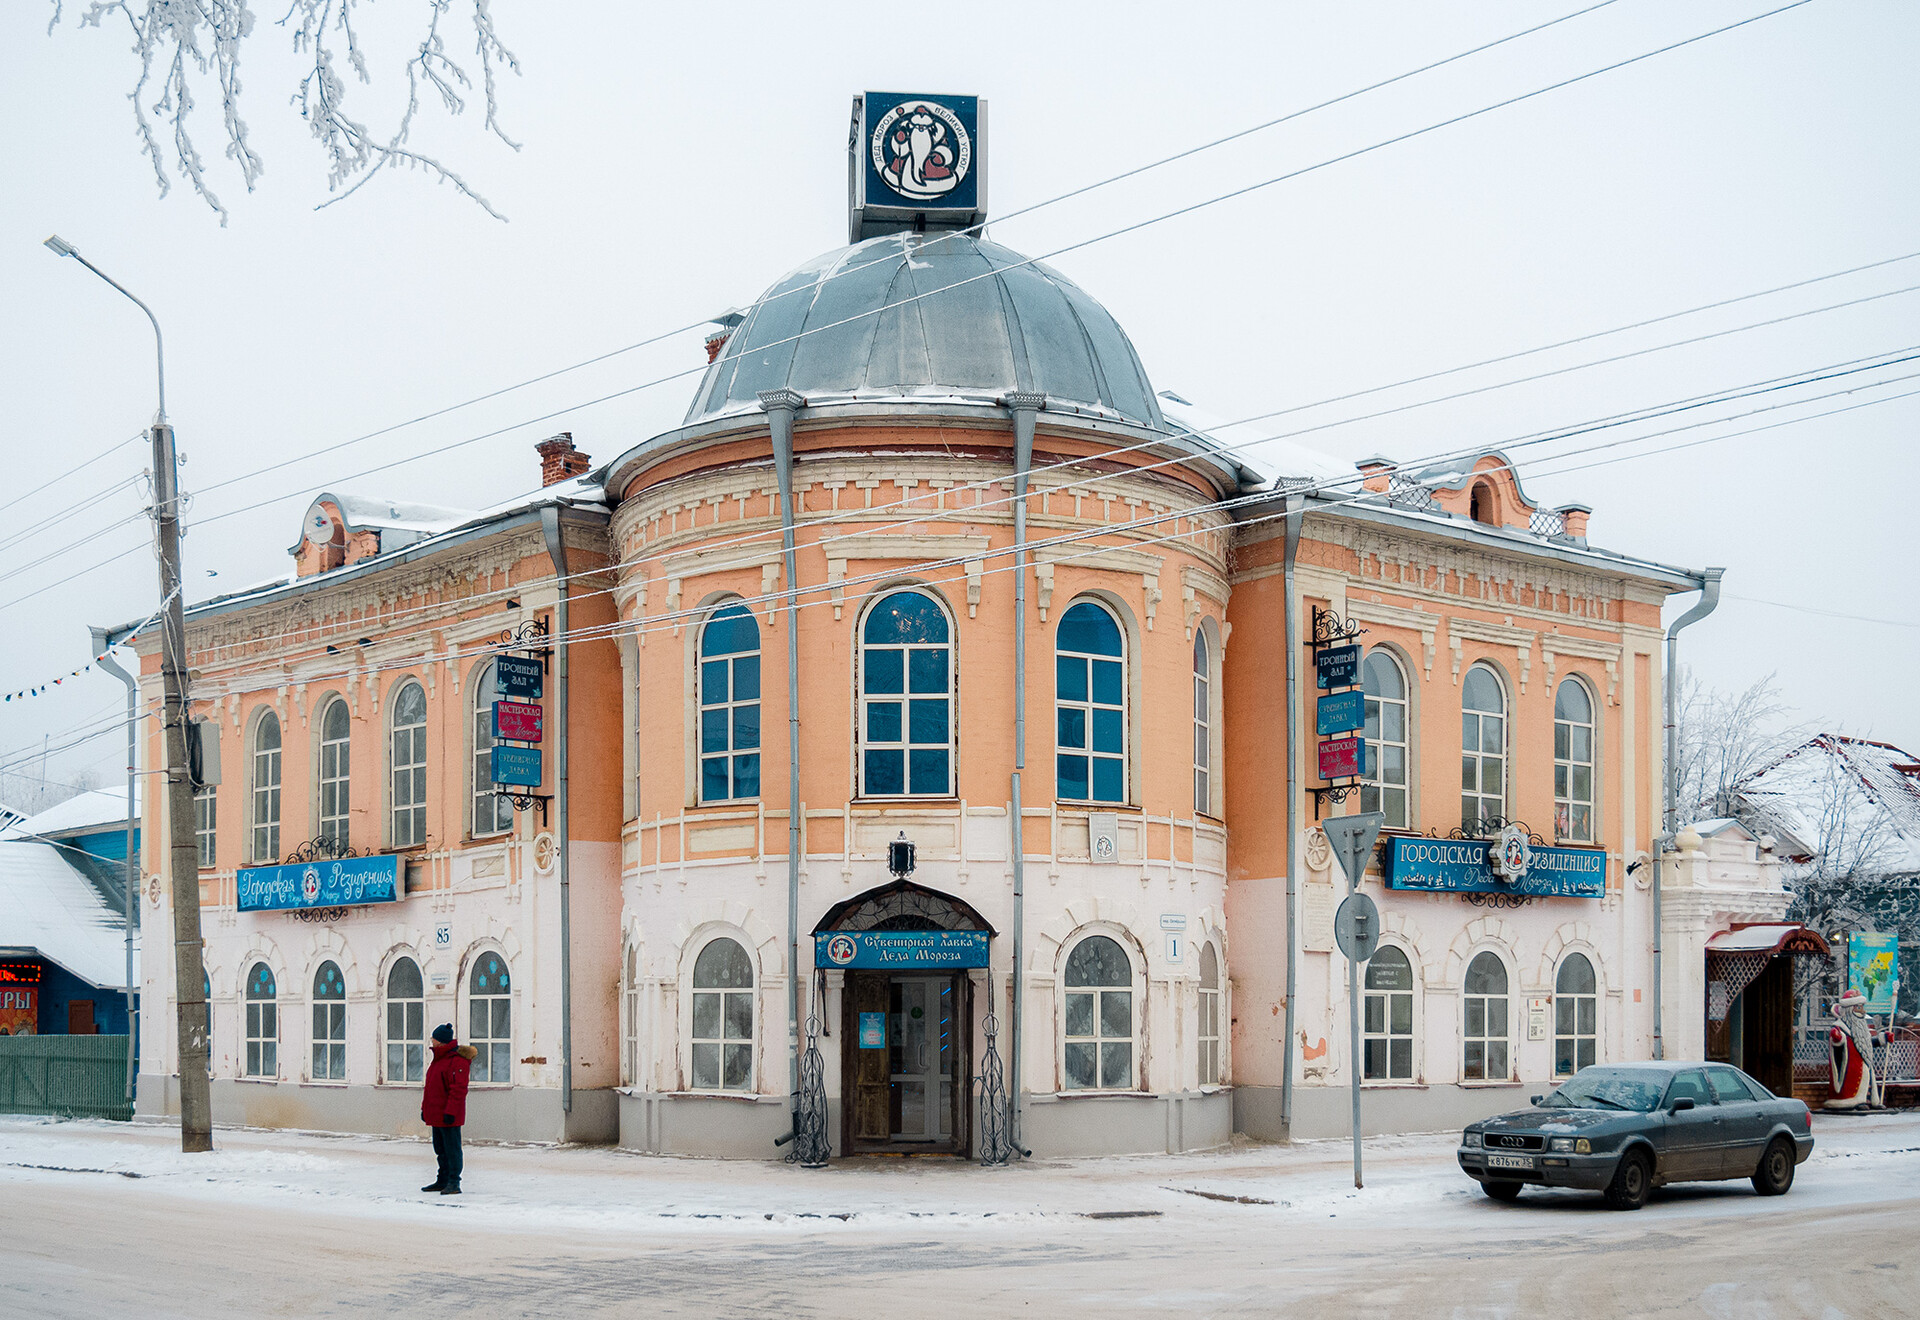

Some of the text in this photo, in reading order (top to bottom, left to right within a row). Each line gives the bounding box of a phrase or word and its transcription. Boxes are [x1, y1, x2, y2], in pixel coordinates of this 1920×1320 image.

[874, 115, 894, 163] ДЕД МОРОЗ
[934, 107, 969, 171] ВЕЛИКИЙ УСТЮГ
[1319, 652, 1356, 666] ТРОННЫЙ
[499, 661, 539, 676] ТРОННЫЙ
[1330, 667, 1345, 677] ЗАЛ
[511, 676, 527, 686] ЗАЛ
[499, 704, 541, 717] МАСТЕРСКАЯ
[1320, 741, 1357, 753] МАСТЕРСКАЯ
[1400, 844, 1484, 866] ГОРОДСКАЯ
[242, 862, 394, 906] Городская Резиденция
[1461, 866, 1553, 894] Деда Мороза
[436, 928, 450, 944] 85
[864, 936, 934, 950] Сувенирная
[940, 937, 974, 948] лавка
[1172, 939, 1178, 957] 1
[879, 950, 962, 963] Деда Мороза
[0, 991, 32, 1009] РЫ
